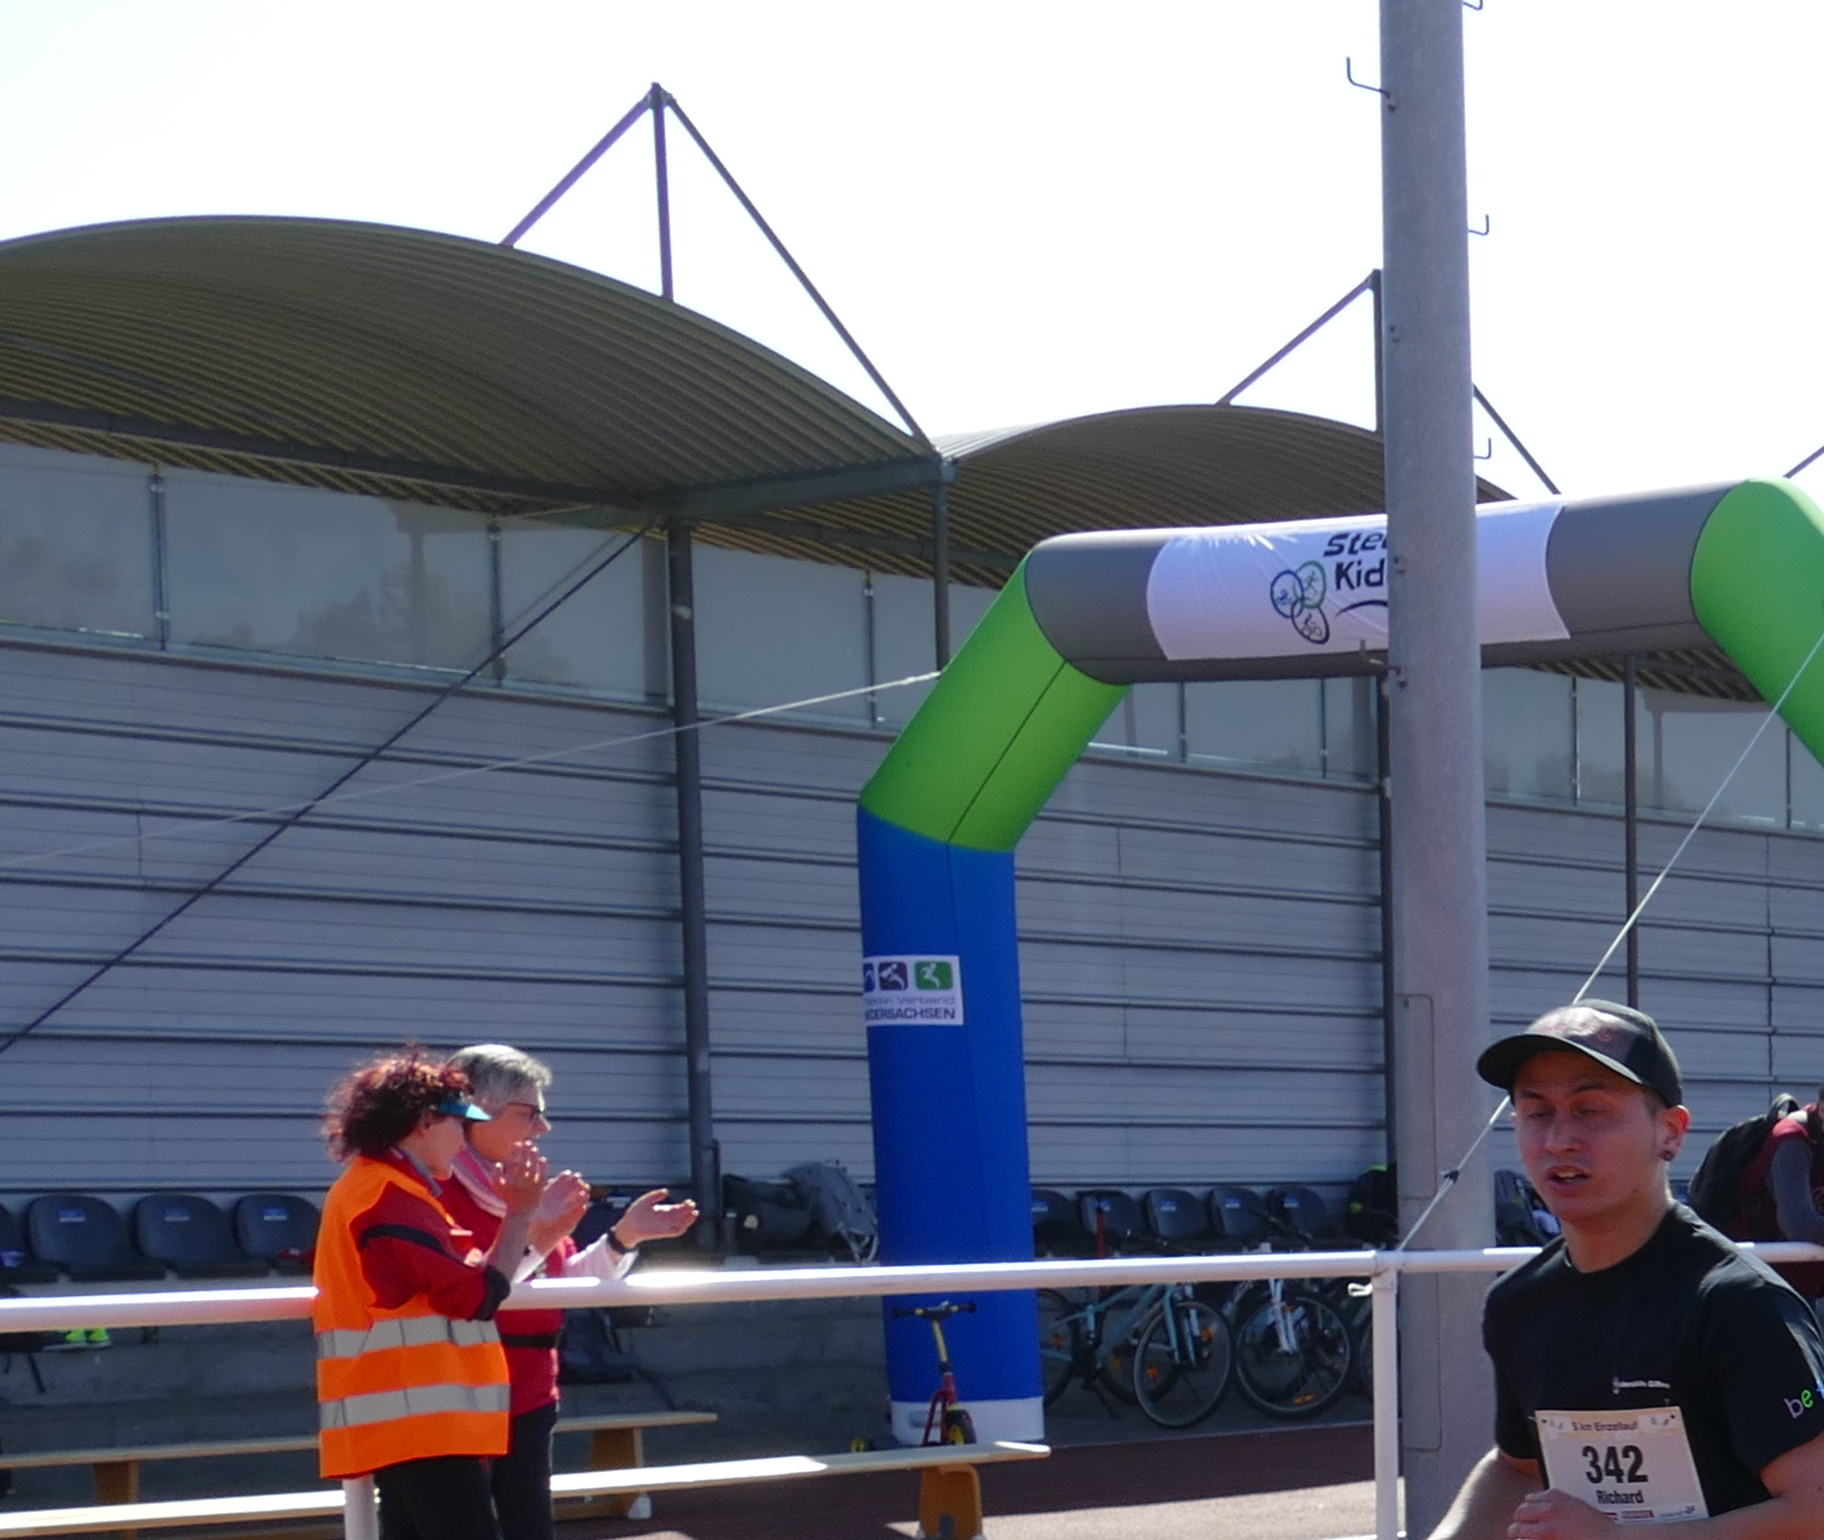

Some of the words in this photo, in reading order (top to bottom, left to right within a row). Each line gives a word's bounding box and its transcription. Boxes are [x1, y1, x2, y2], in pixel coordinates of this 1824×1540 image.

[1335, 558, 1385, 590] Kid
[1572, 1421, 1579, 1431] 5
[1582, 1445, 1649, 1484] 342
[1596, 1489, 1645, 1504] Richard
